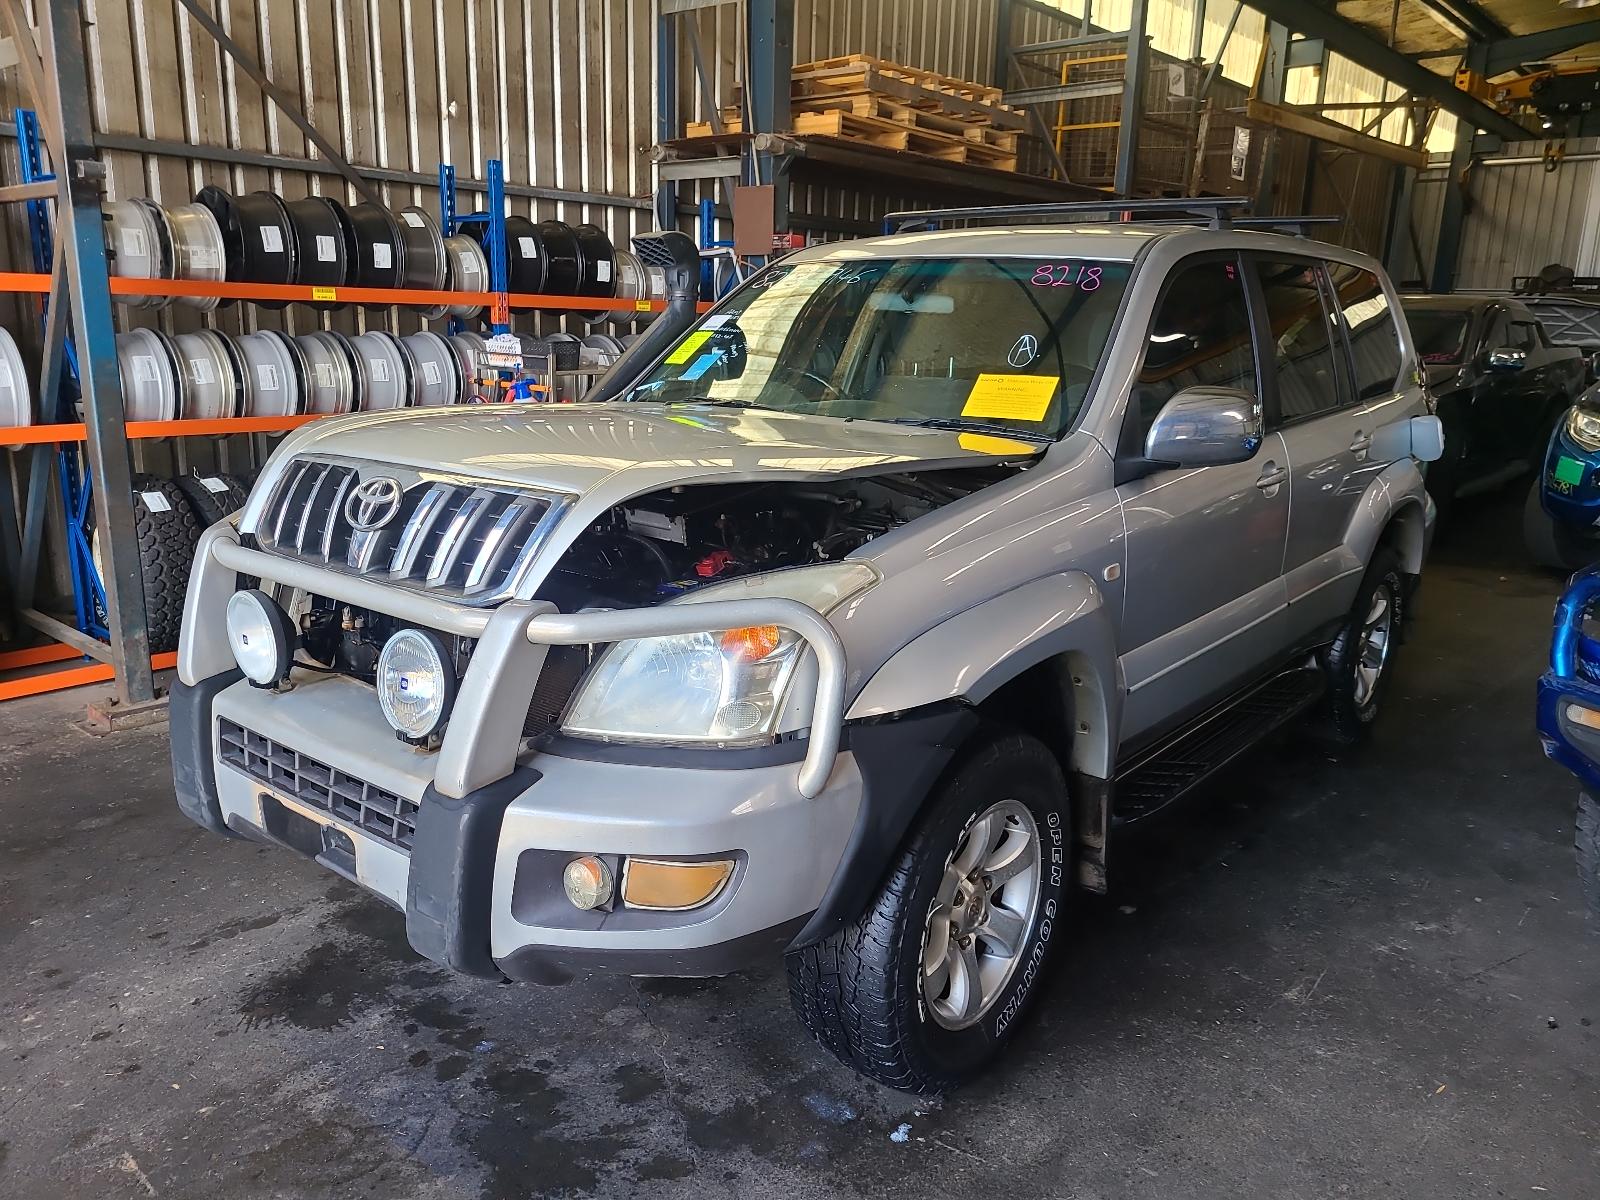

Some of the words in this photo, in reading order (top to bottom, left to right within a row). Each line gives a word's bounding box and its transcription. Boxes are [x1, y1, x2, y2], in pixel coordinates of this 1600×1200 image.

[1030, 264, 1103, 291] 8218
[1047, 812, 1063, 886] OPEN
[995, 899, 1057, 1038] COUNTRY
